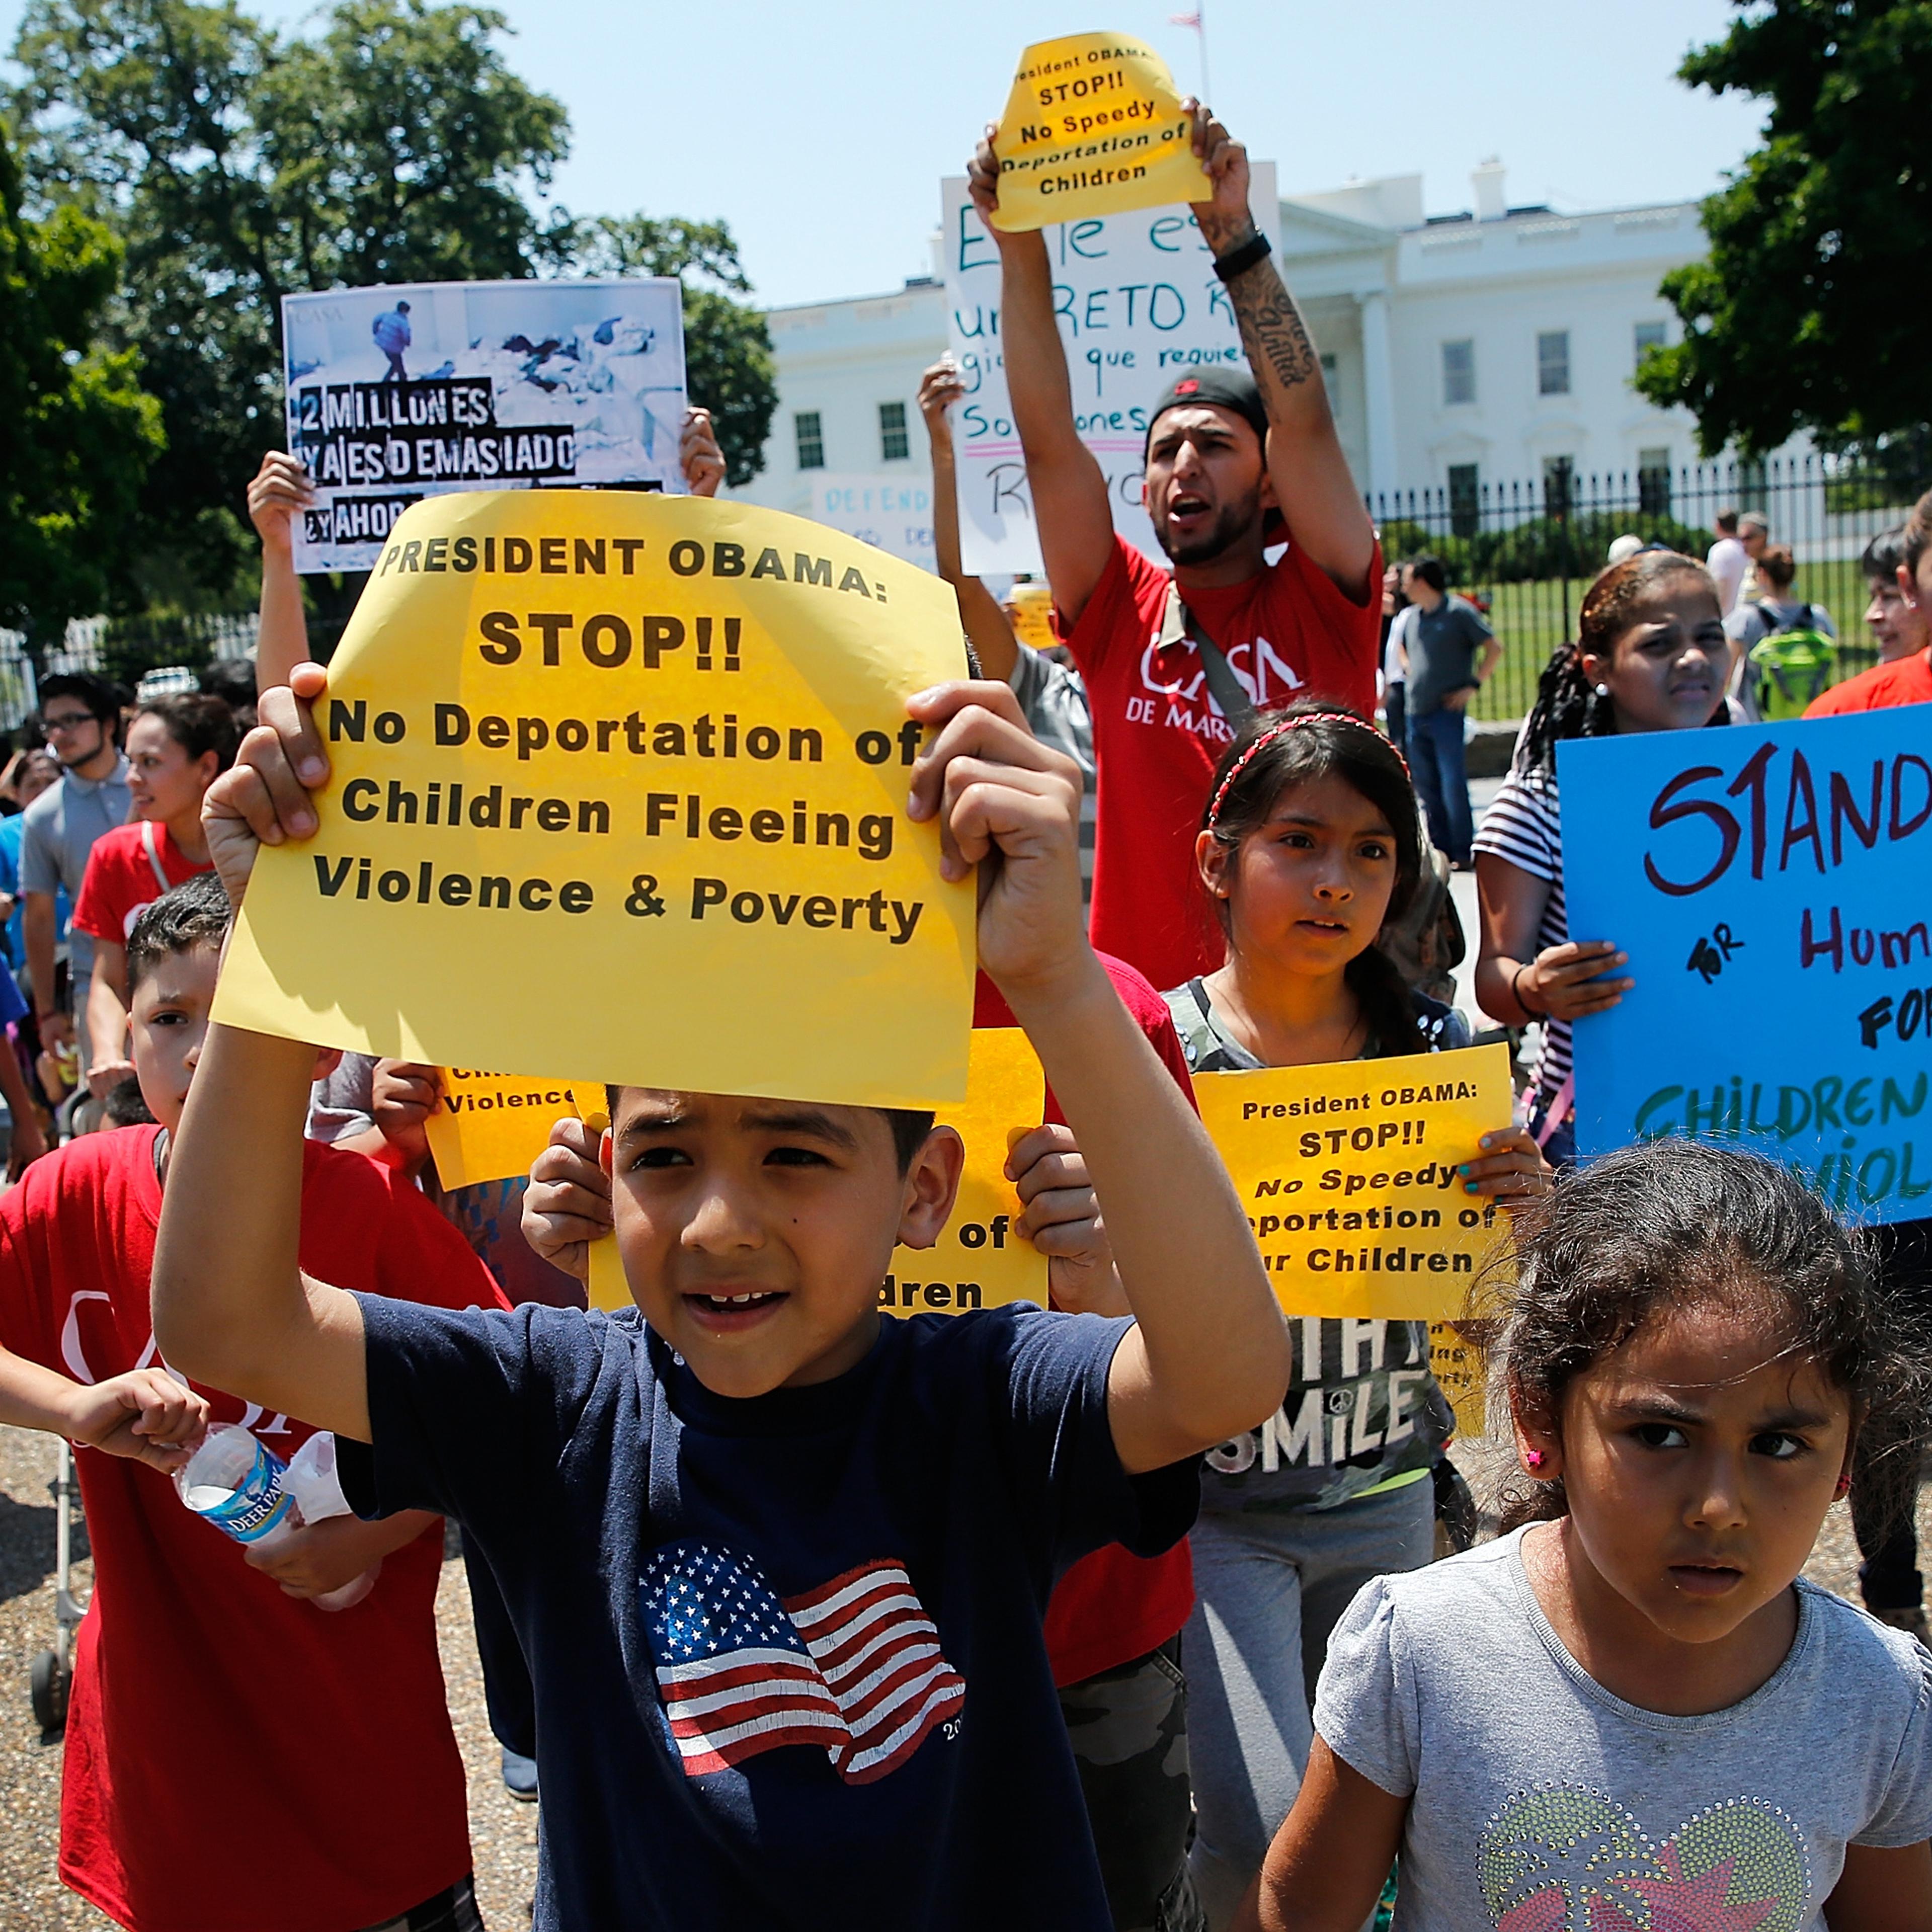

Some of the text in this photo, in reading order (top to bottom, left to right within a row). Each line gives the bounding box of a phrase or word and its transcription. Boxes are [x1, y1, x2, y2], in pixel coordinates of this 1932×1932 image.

[1015, 56, 1080, 84] resident
[1040, 71, 1123, 106] STOP!!
[1021, 101, 1155, 144] No Speedy
[1001, 122, 1185, 173] Deportation of
[1040, 165, 1146, 195] Children
[1087, 347, 1135, 397] que
[302, 387, 490, 431] 2 MILLONES
[302, 433, 575, 480] YA ES DEMASIADO
[380, 536, 889, 604] PRESIDENT OBAMA:
[478, 612, 743, 672] STOP!!
[1125, 696, 1156, 725] DE
[329, 699, 924, 766] No Deportation of
[342, 778, 895, 861] Children Fleeing
[1644, 742, 1932, 896] STAND
[313, 854, 924, 945] Violence & Poverty
[443, 1089, 575, 1114] Violence
[1243, 1081, 1477, 1120] President OBAMA:
[1299, 1120, 1425, 1158] STOP!!
[1254, 1162, 1458, 1198] No Speedy
[959, 1215, 1009, 1249] of
[1459, 1203, 1496, 1228] of
[1307, 1248, 1473, 1272] Children
[877, 1274, 982, 1307] dren
[227, 1505, 271, 1533] DEER
[263, 1464, 283, 1507] PARK
